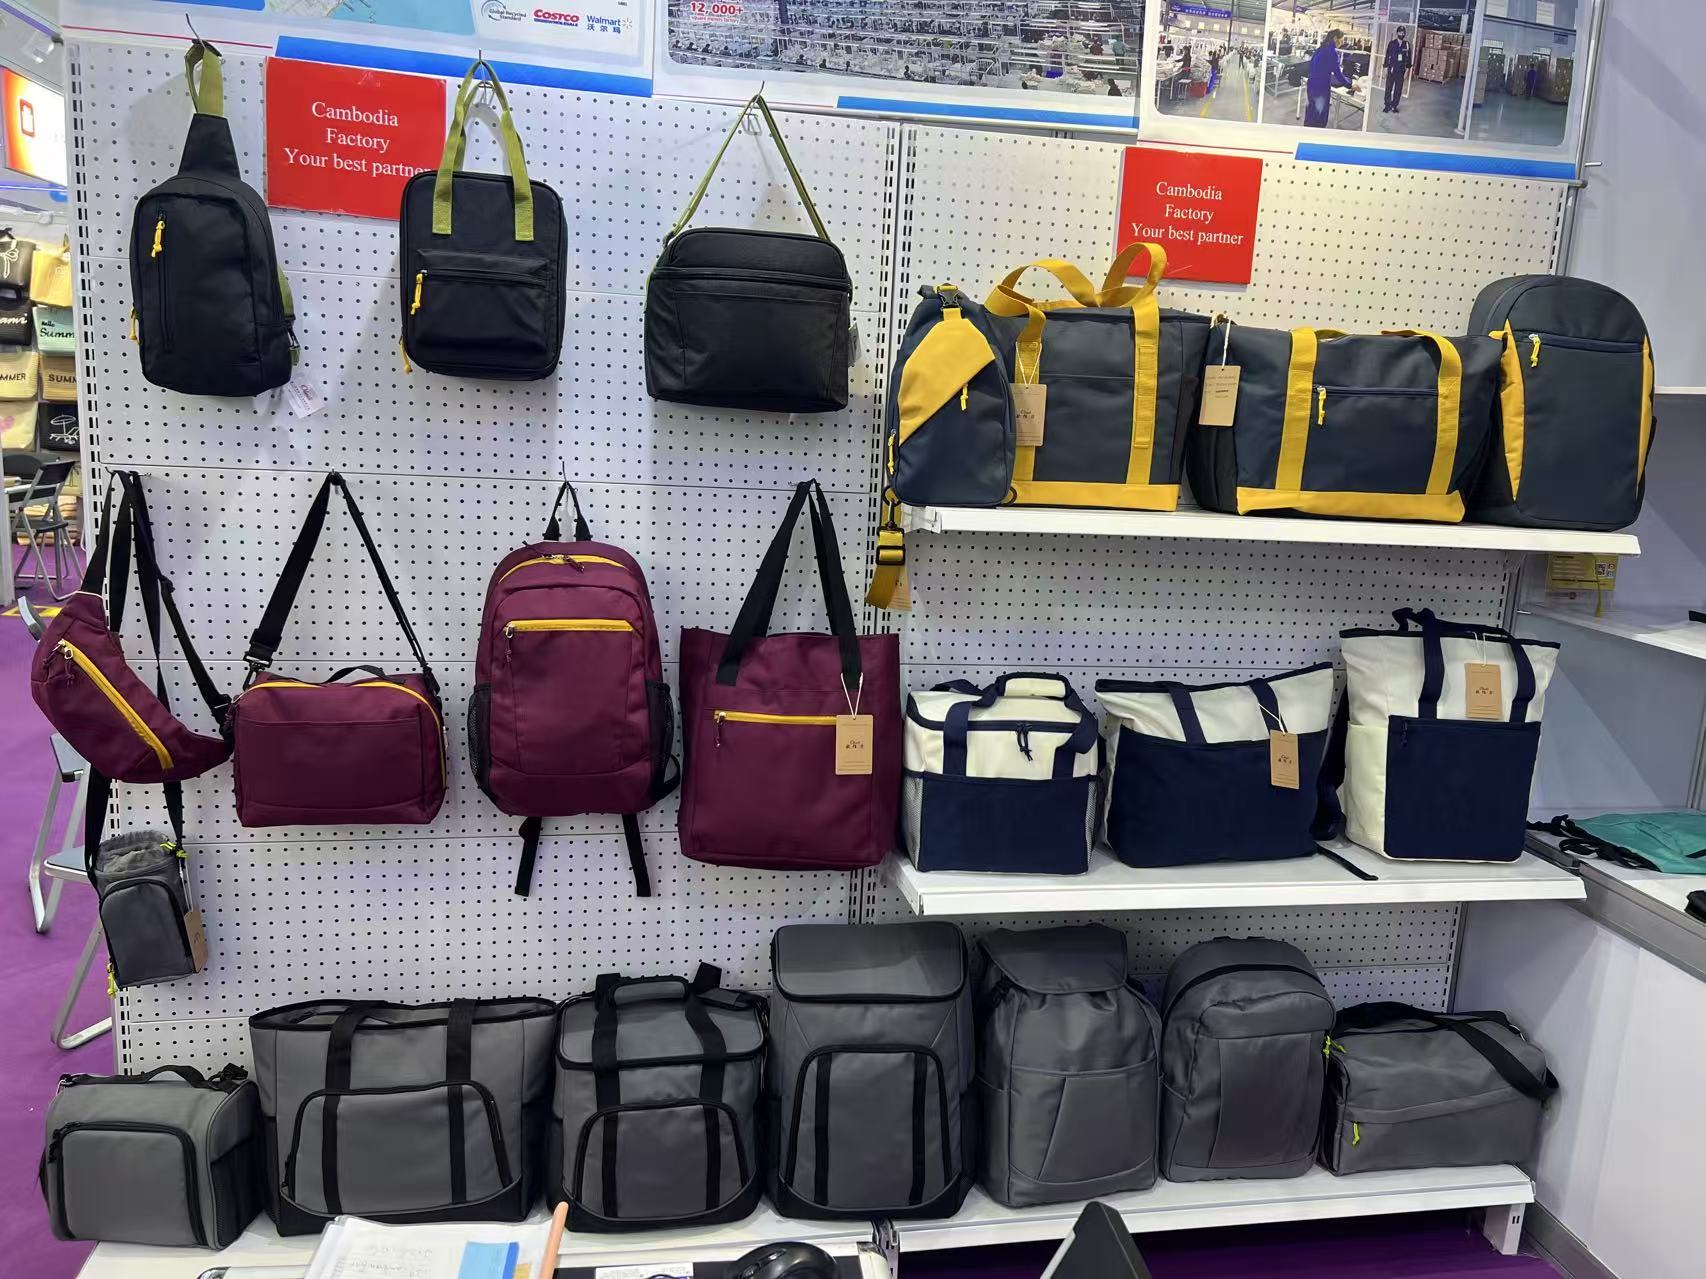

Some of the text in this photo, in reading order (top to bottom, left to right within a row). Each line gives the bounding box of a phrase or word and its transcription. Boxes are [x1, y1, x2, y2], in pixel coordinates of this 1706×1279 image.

[505, 10, 527, 18] Recycled
[586, 15, 621, 26] Walmart
[587, 23, 621, 34] 沃尔玛
[311, 101, 399, 127] Cambodia
[325, 127, 391, 154] Factory
[284, 147, 328, 168] Your
[333, 153, 368, 173] best
[1156, 181, 1223, 201] Cambodia
[1165, 203, 1215, 225] Factory
[1131, 222, 1244, 246] Your best partner
